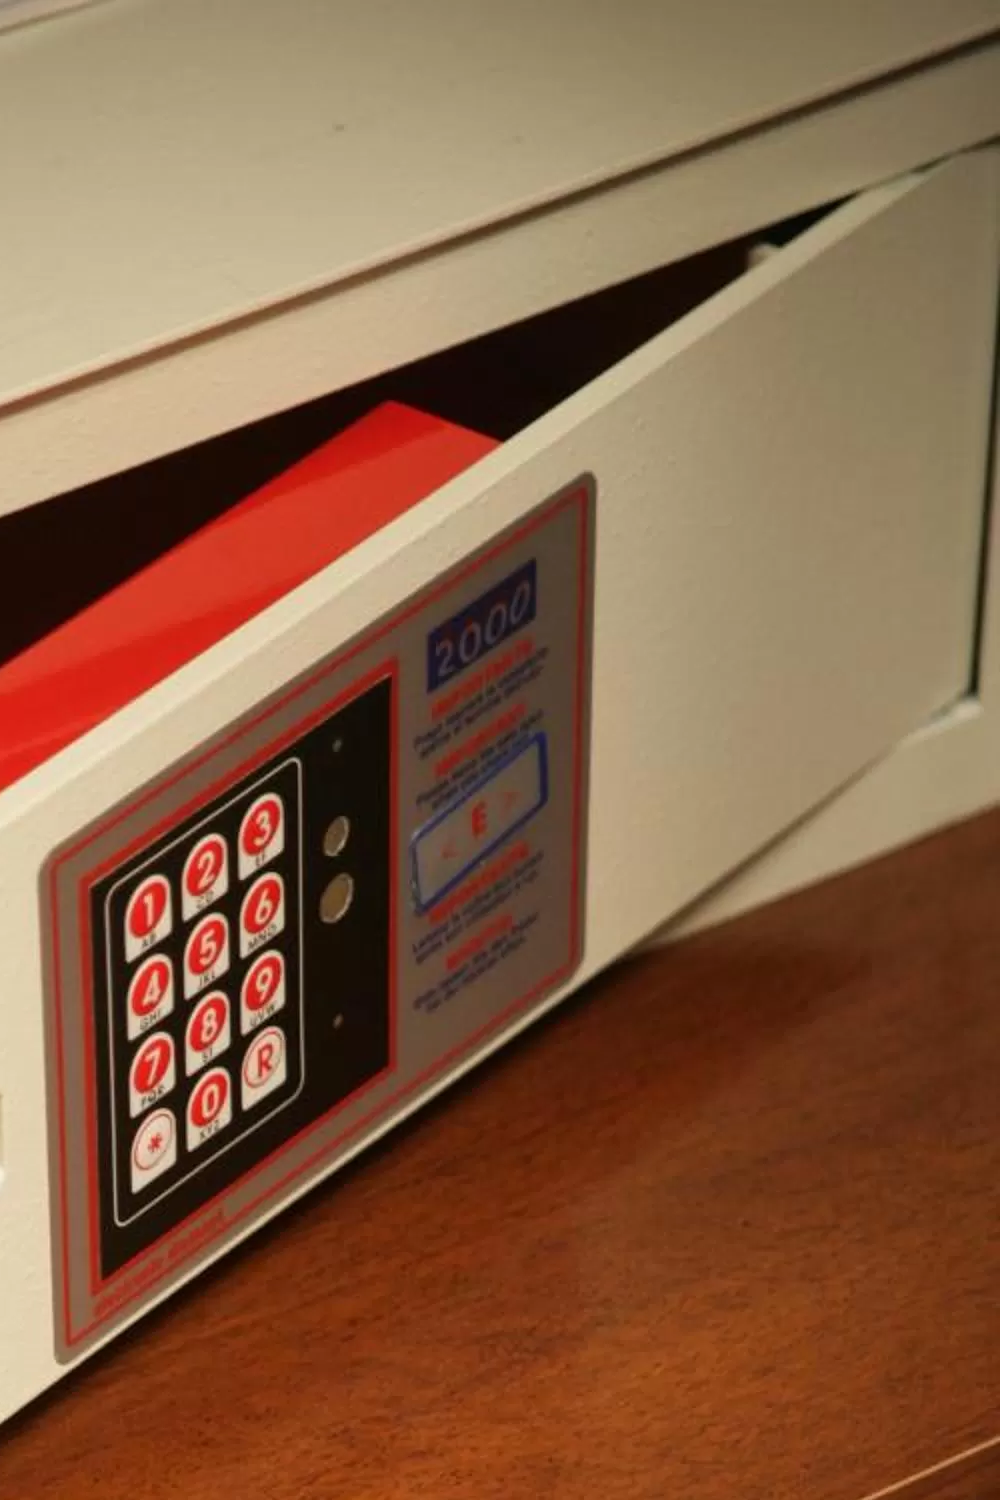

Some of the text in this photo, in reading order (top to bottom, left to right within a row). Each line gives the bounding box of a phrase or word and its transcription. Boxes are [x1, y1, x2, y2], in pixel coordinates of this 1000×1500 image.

[434, 583, 532, 677] 2000
[253, 809, 272, 846] 3
[197, 850, 215, 890] 2
[143, 892, 153, 930] 1
[255, 888, 273, 925] 6
[199, 928, 217, 965] 5
[142, 971, 161, 1007] 4
[255, 966, 273, 1001] 9
[201, 1007, 218, 1042] 8
[146, 1048, 162, 1083] 7
[257, 1043, 273, 1077] R
[202, 1083, 219, 1118] 0
